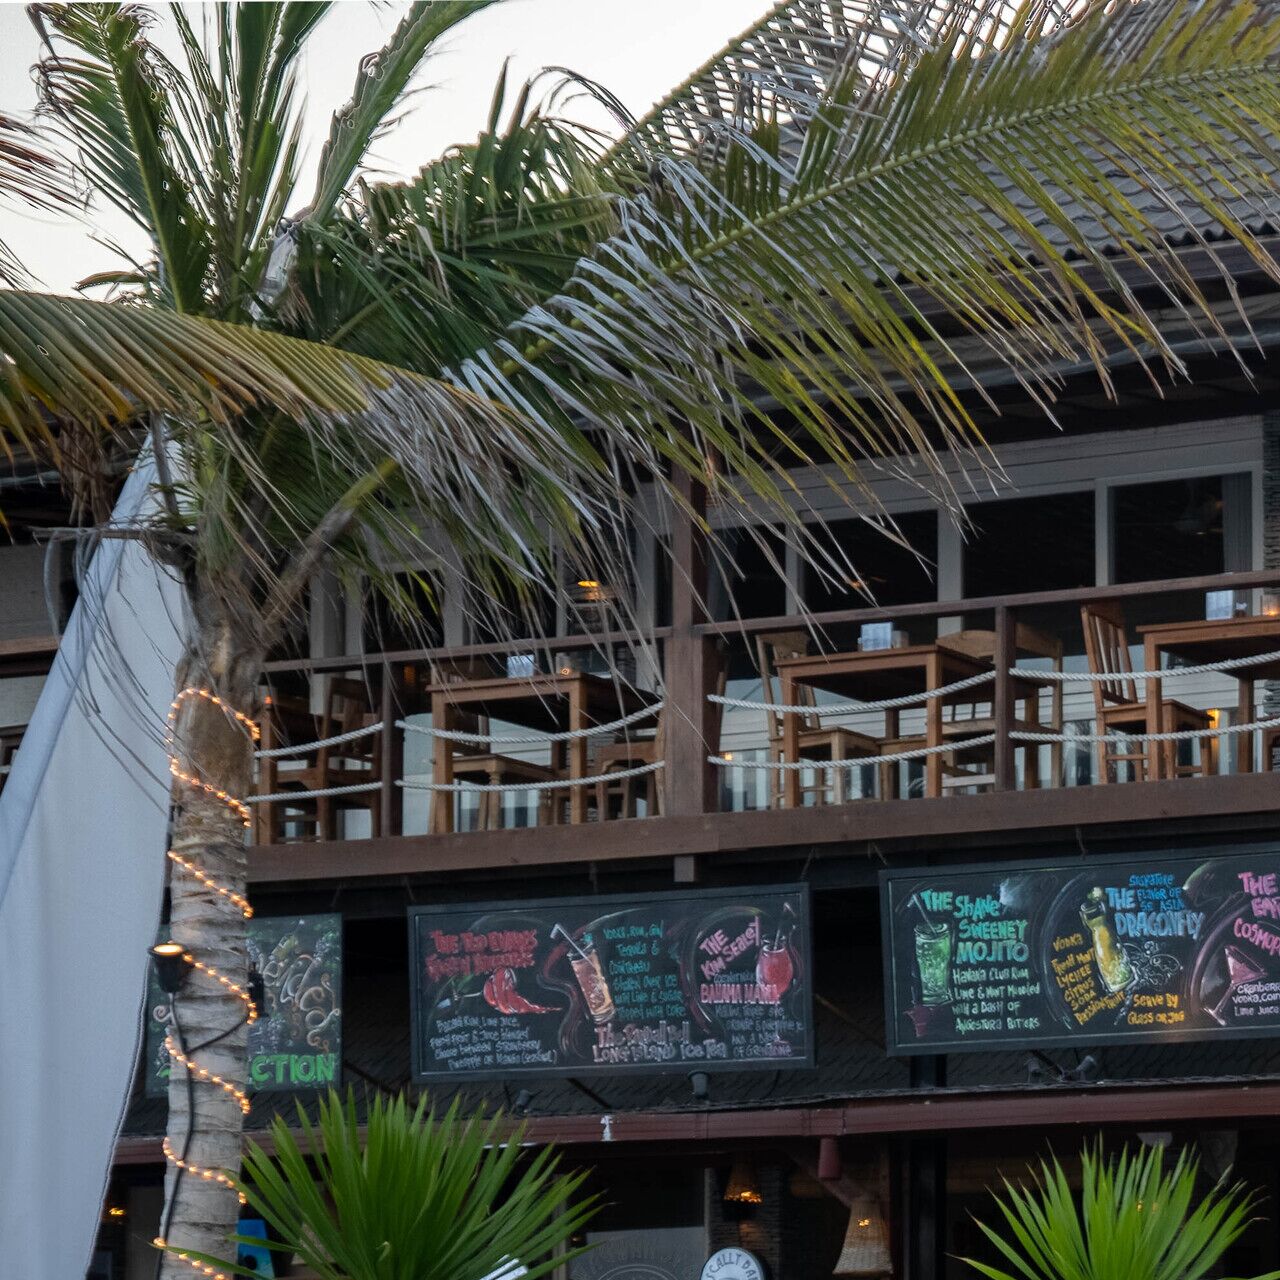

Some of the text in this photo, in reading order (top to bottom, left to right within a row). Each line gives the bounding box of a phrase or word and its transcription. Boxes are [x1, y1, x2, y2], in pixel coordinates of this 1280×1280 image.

[1237, 870, 1279, 897] THE
[920, 889, 953, 911] THE
[1104, 886, 1136, 911] THE
[958, 919, 1029, 941] SWEENEY
[1114, 910, 1207, 941] DRAGONFLY
[698, 927, 730, 958] THE
[956, 939, 1030, 965] MOJITO
